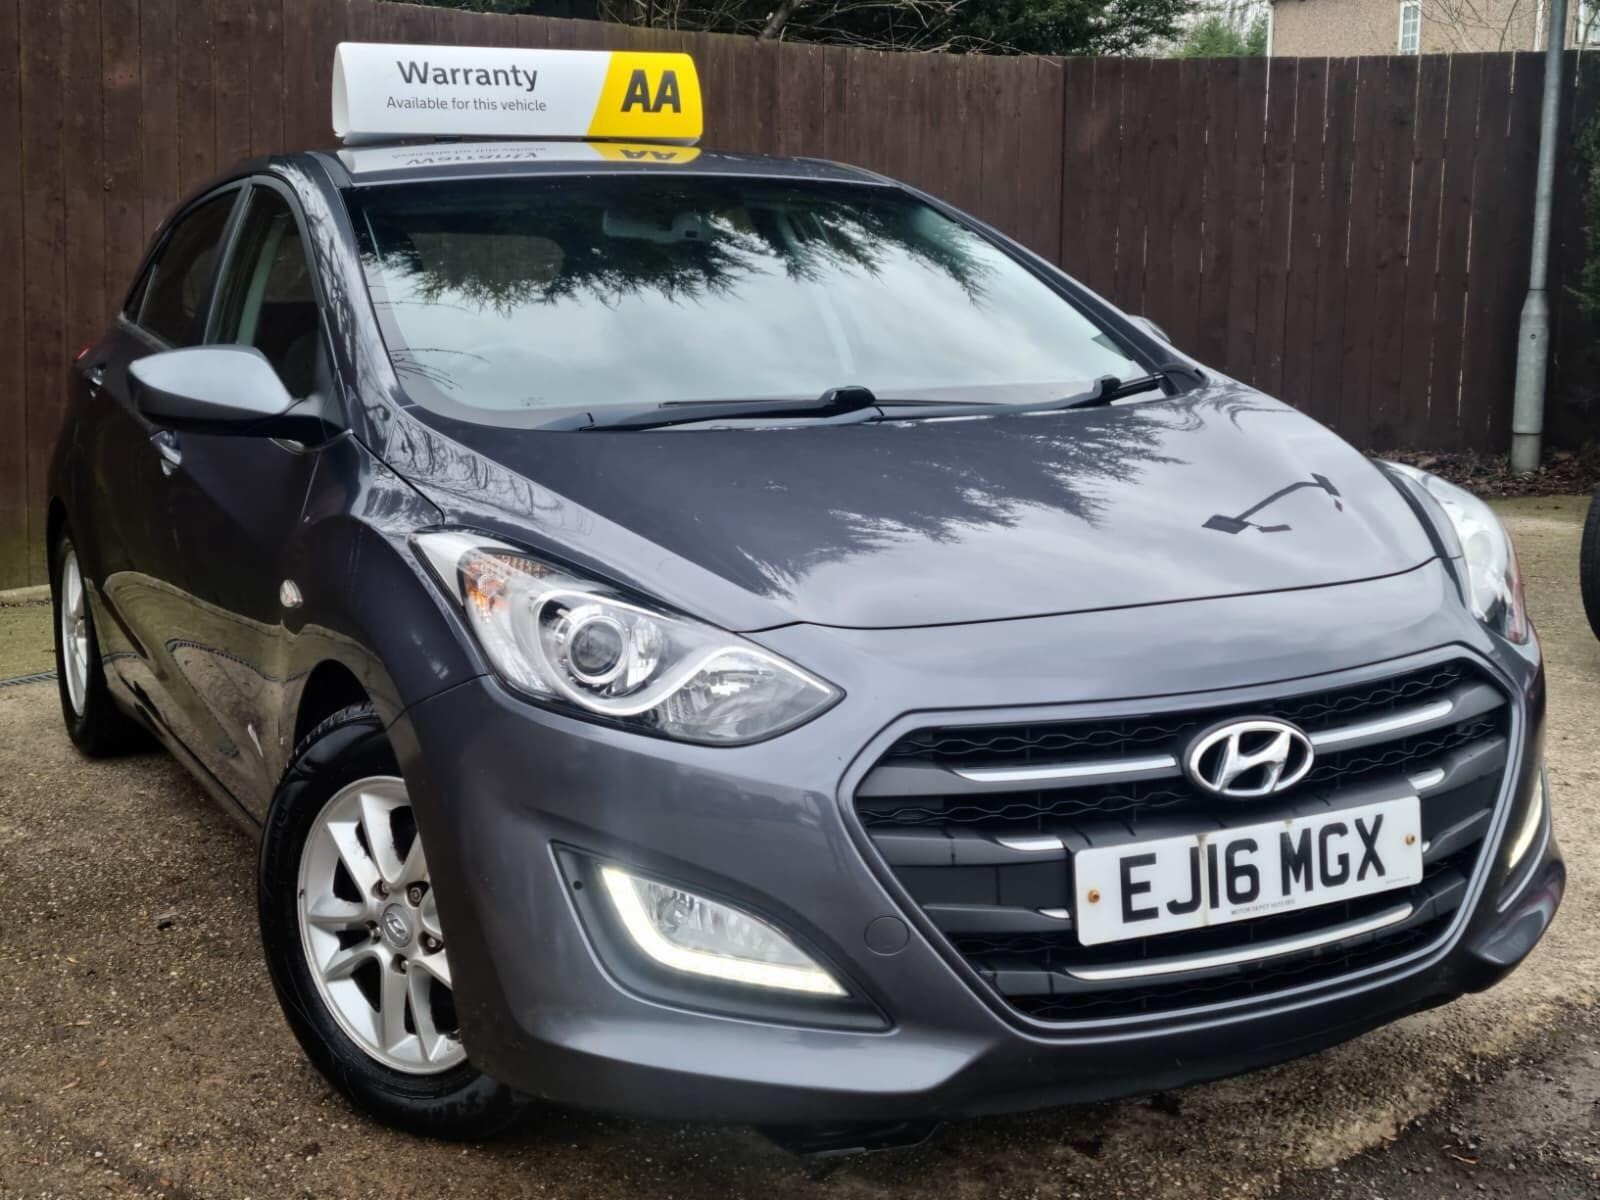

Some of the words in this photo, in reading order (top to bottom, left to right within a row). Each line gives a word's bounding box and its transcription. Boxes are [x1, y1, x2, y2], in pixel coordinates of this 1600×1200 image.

[396, 61, 538, 92] Warranty
[620, 69, 682, 114] AA
[386, 96, 449, 110] Available
[452, 97, 470, 110] for
[473, 98, 498, 111] this
[500, 99, 547, 112] vehicle
[1119, 838, 1260, 924] EJ16
[1279, 813, 1386, 896] MGX
